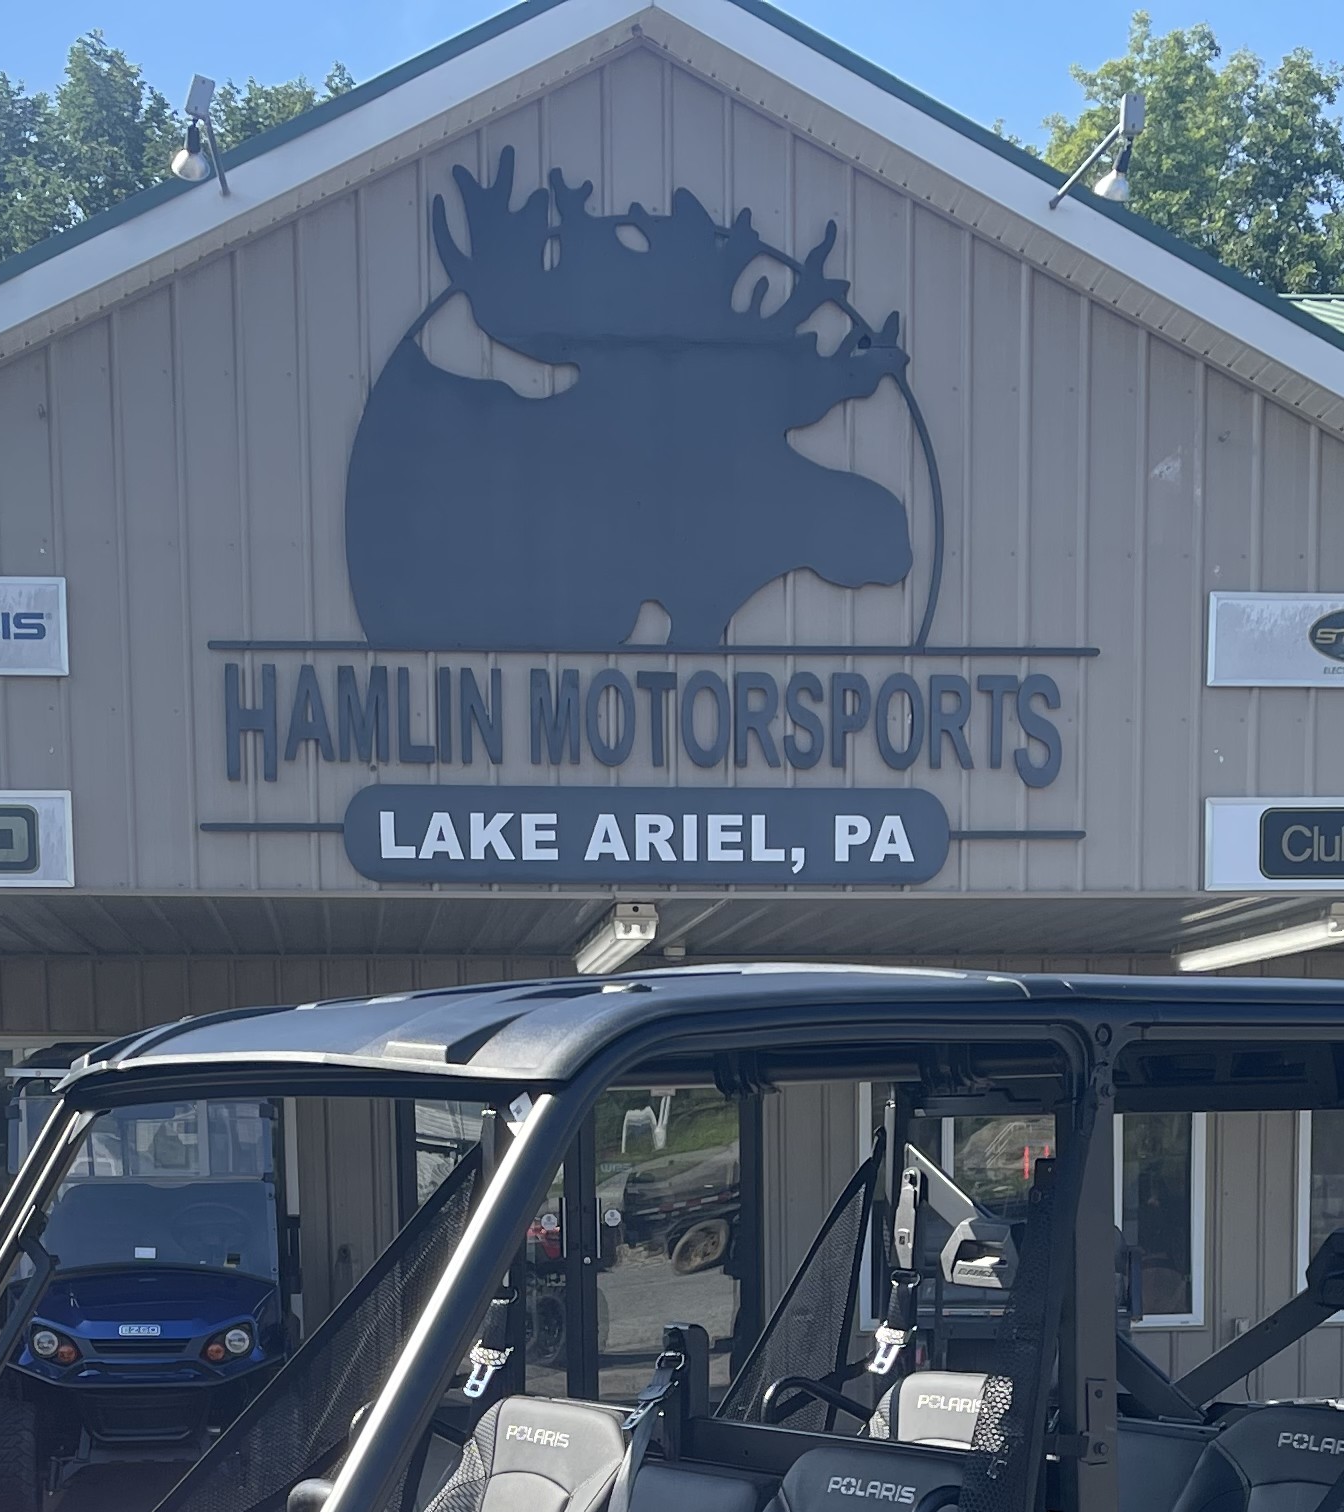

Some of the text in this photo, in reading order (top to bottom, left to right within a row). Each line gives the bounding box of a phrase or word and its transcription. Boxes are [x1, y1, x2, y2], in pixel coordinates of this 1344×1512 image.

[224, 663, 1062, 788] HAMLIN MOTORSPORTS
[379, 811, 915, 874] LAKE ARIEL, PA
[505, 1424, 570, 1449] POLARIS
[827, 1476, 916, 1504] POLARIS
